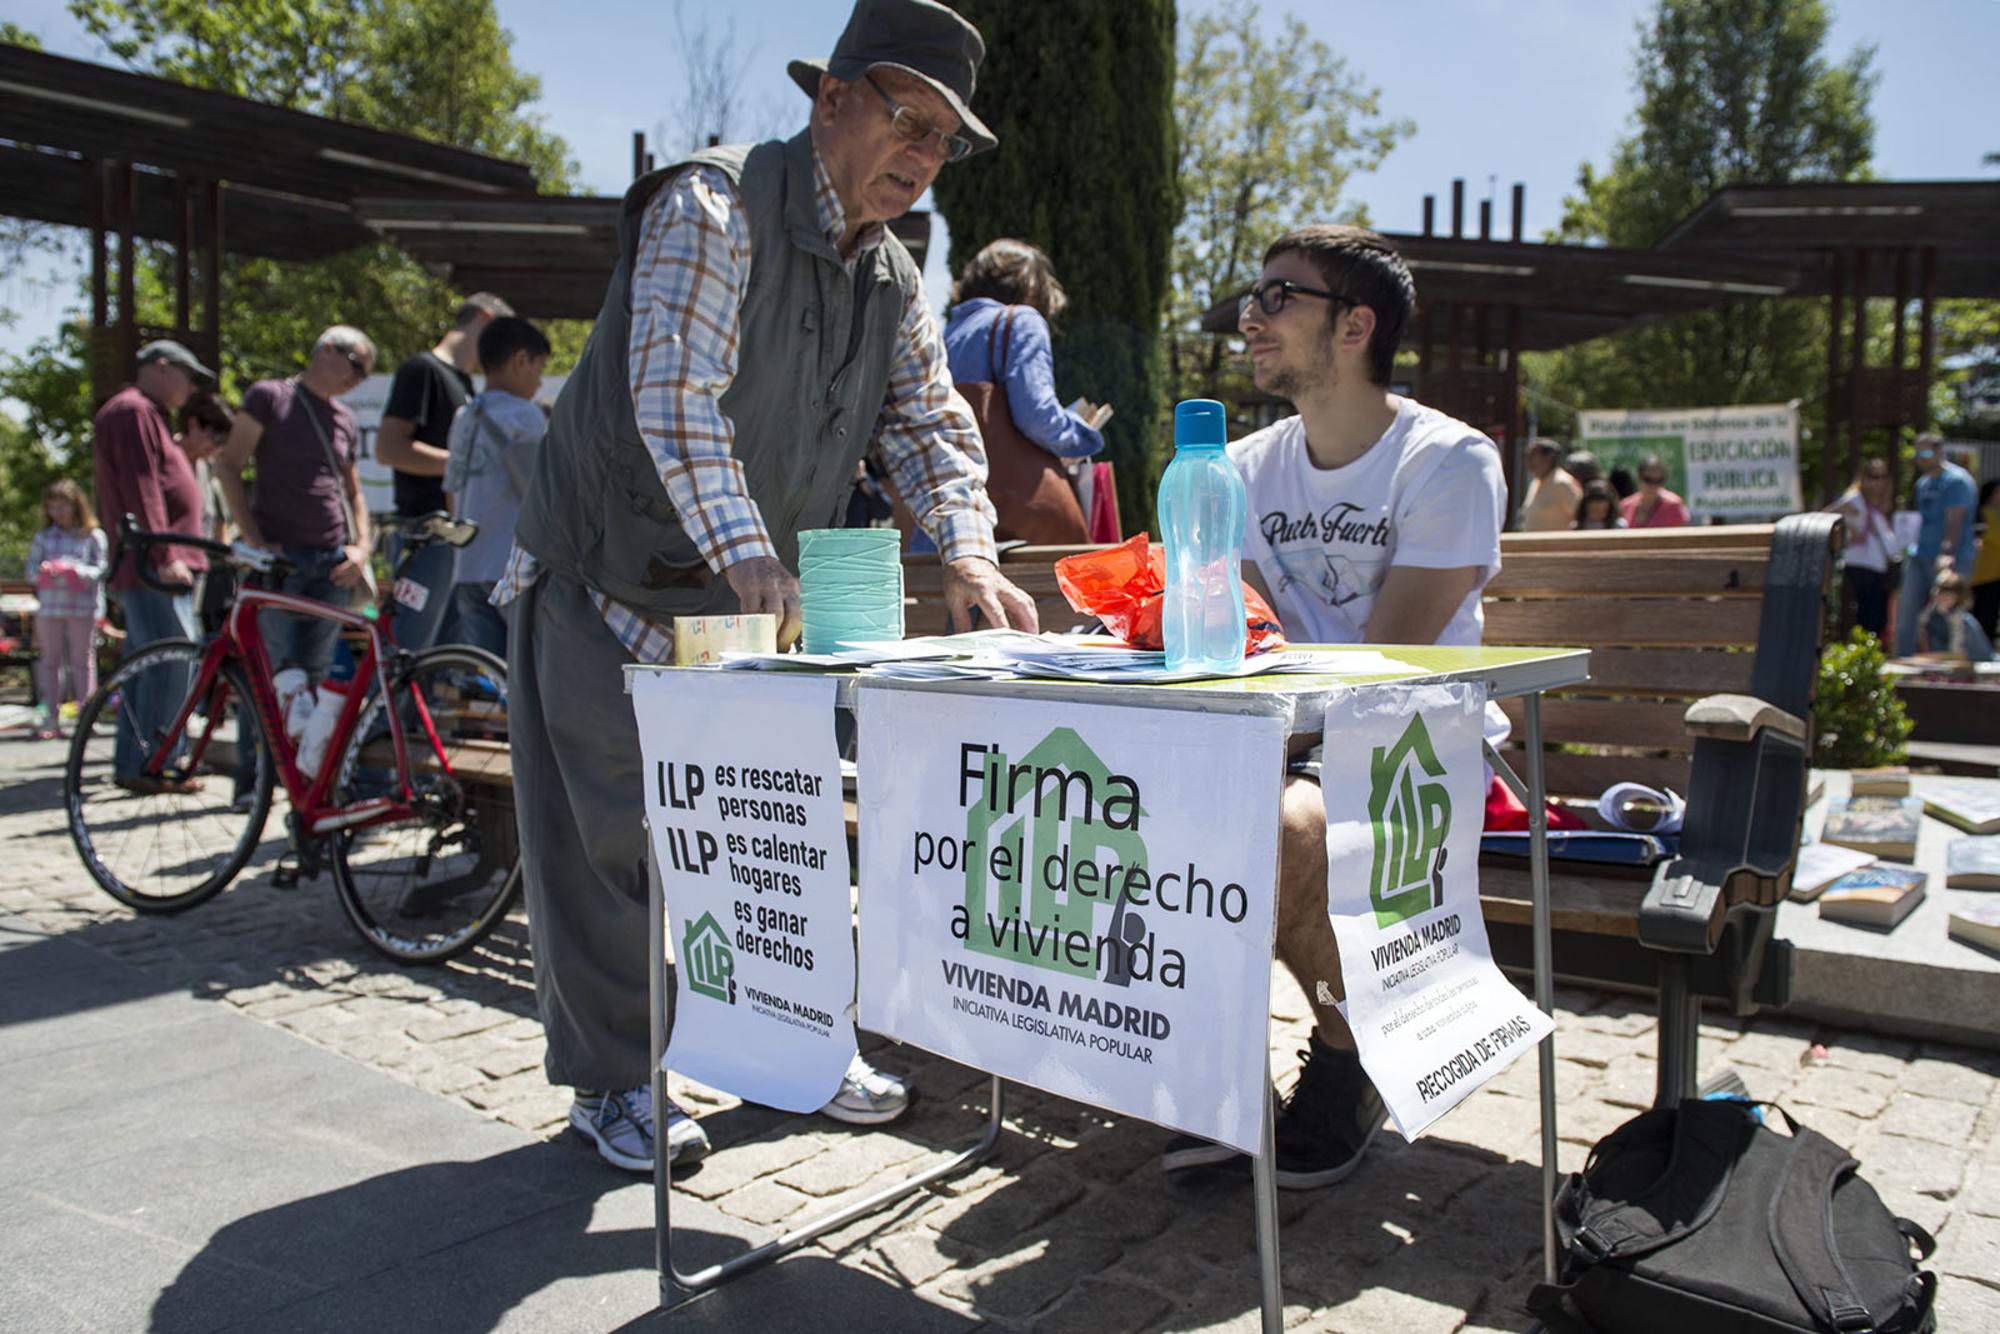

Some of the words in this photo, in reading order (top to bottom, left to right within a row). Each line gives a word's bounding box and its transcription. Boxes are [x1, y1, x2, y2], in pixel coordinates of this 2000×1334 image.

[657, 760, 705, 810] ILP
[715, 764, 736, 787] es
[742, 767, 822, 797] rescatar
[717, 794, 807, 827] personas
[959, 742, 1141, 832] Firma
[666, 826, 719, 876] ILP
[726, 832, 748, 856] es
[752, 833, 828, 871] calentar
[728, 856, 802, 897] hogares
[914, 830, 976, 875] por
[989, 837, 1024, 884] el
[1043, 844, 1248, 924] derecho
[734, 900, 752, 924] es
[757, 905, 808, 937] ganar
[1371, 930, 1423, 972] VIVIENDA
[1420, 913, 1462, 948] MADRID
[736, 925, 814, 972] derechos
[950, 904, 970, 941] a
[987, 909, 1187, 990] vivienda
[745, 985, 791, 1013] VIVIENDA
[793, 1002, 834, 1028] MADRID
[941, 959, 1051, 1013] VIVIENDA
[1058, 990, 1171, 1041] MADRID
[952, 996, 1010, 1026] INICIATIVA
[1011, 1012, 1087, 1048] LEGISLATIVA
[1089, 1033, 1153, 1065] POPULAR
[1416, 1048, 1482, 1104] RECOGIDA
[1473, 1037, 1497, 1063] DE
[1489, 1014, 1532, 1051] FIRMAS
